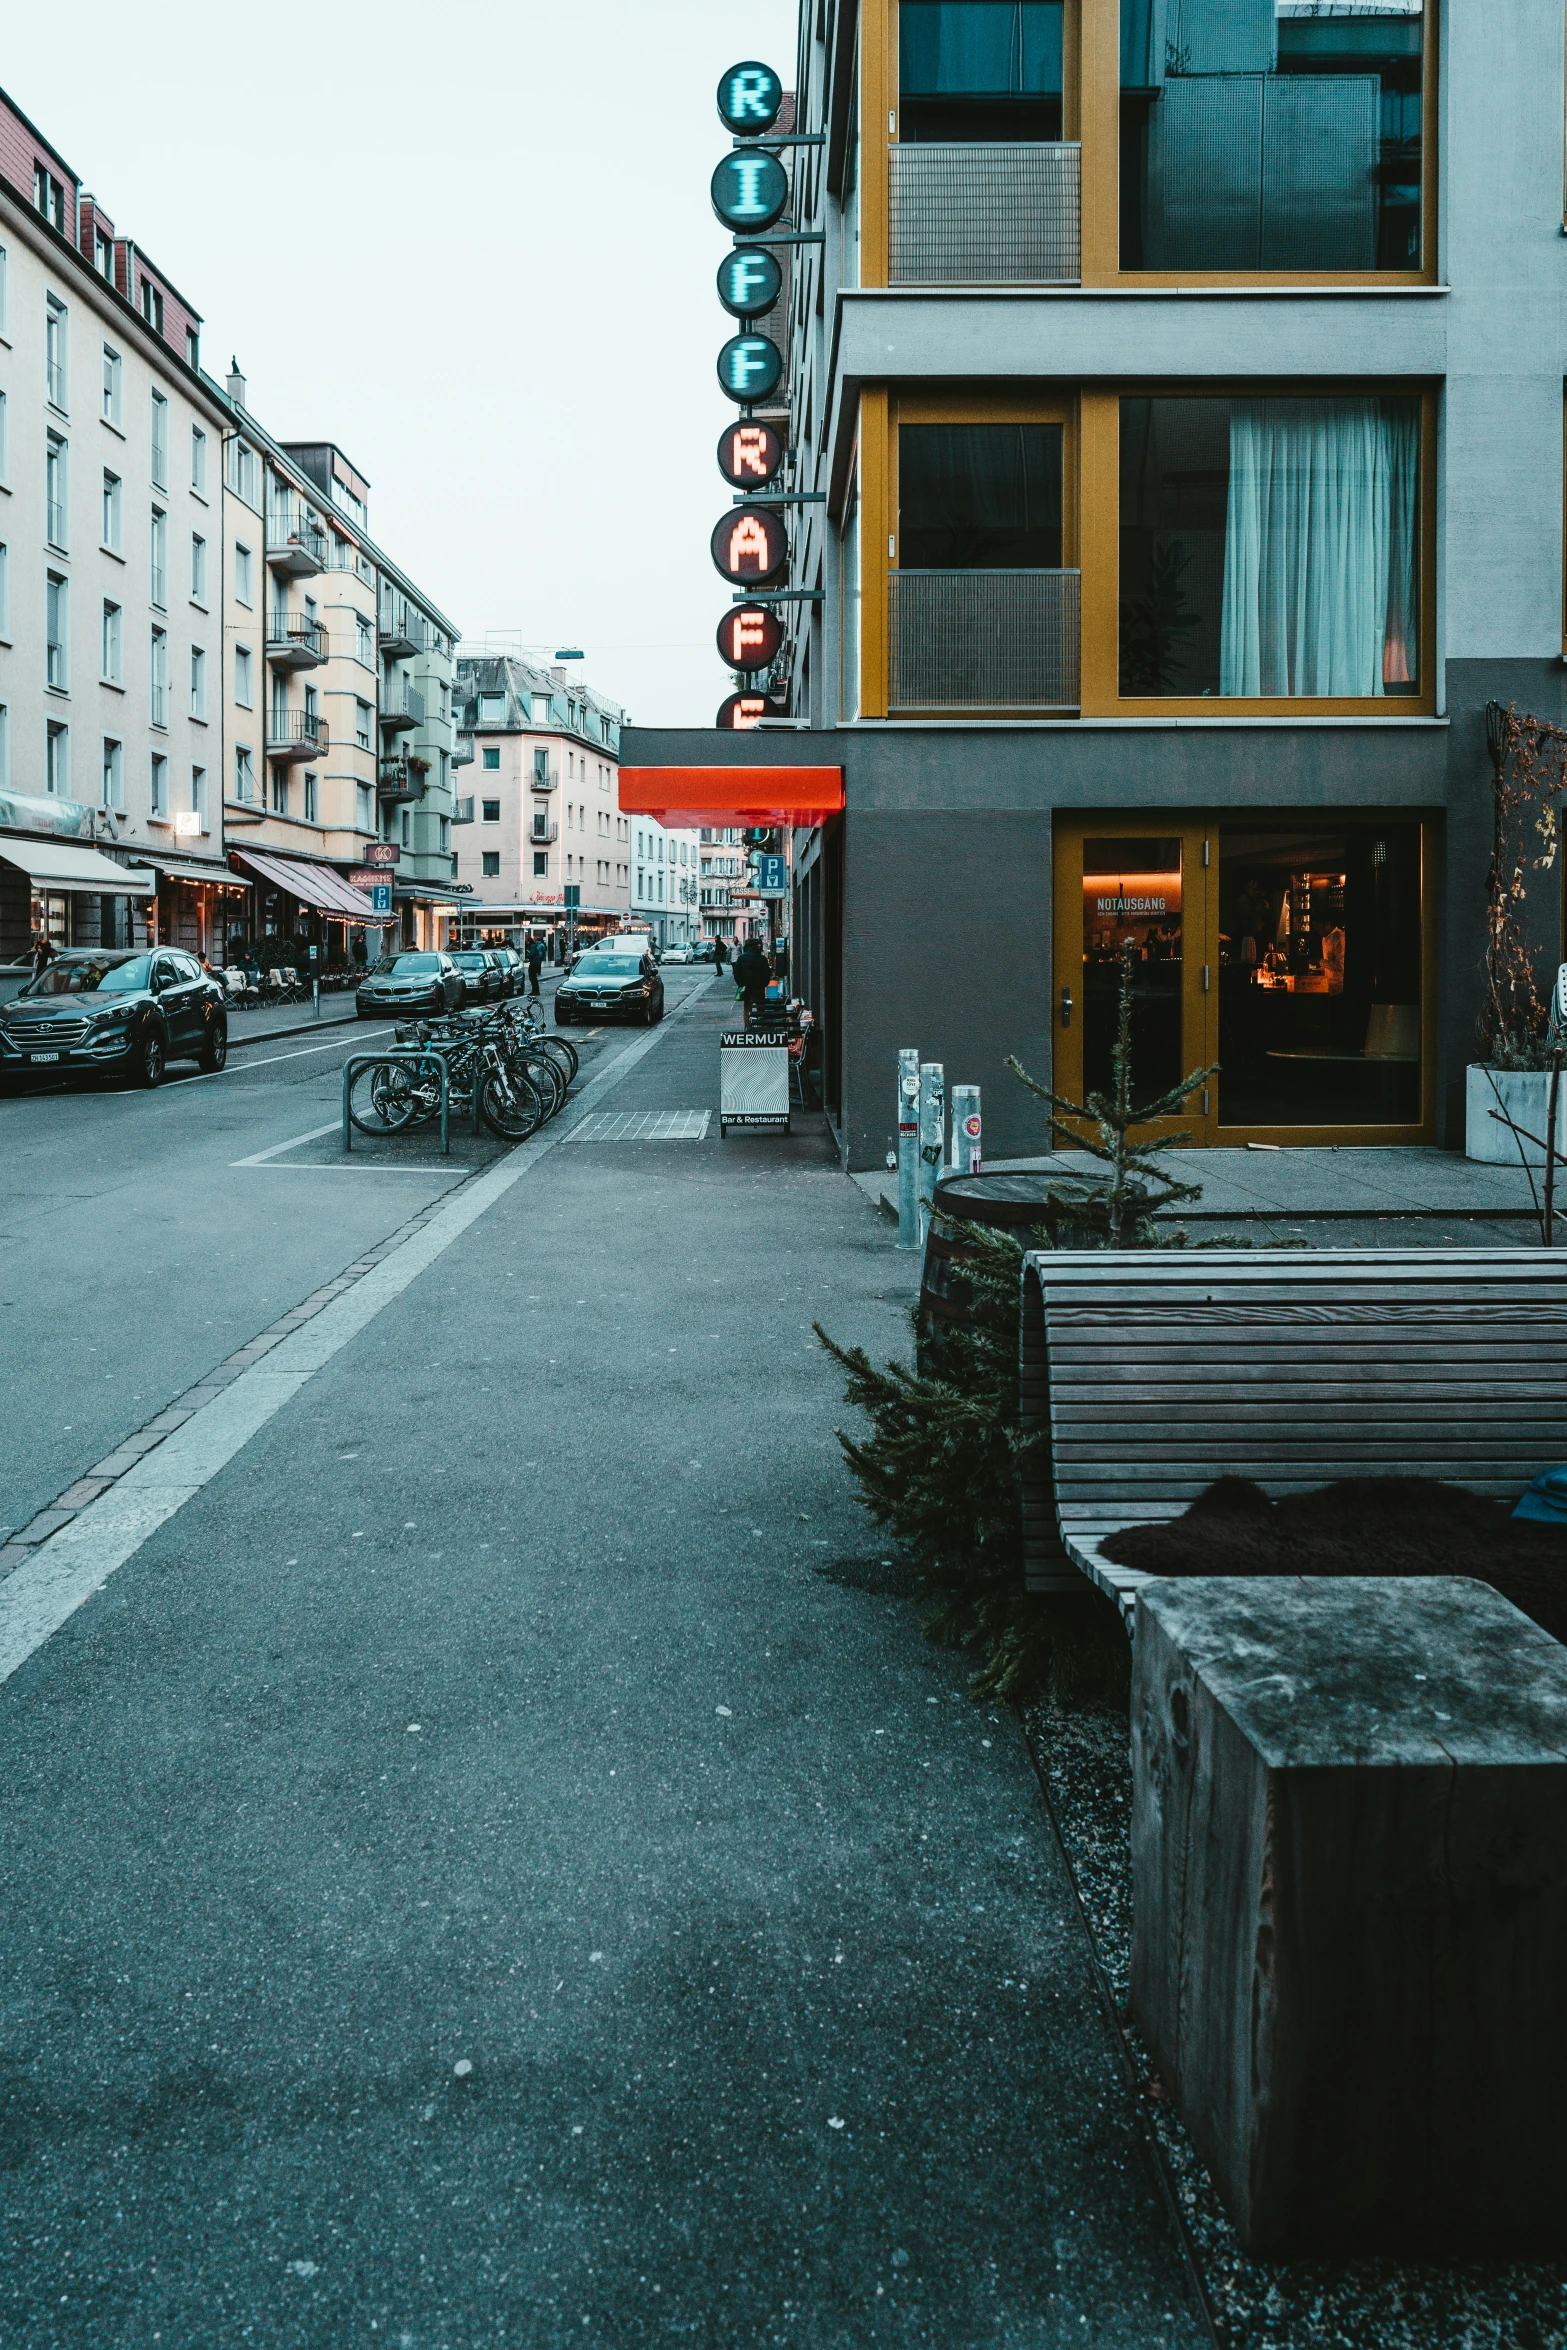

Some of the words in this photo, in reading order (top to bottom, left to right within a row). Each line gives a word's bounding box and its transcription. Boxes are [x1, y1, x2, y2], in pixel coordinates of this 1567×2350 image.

[768, 858, 778, 875] P
[378, 888, 386, 900] P
[1097, 898, 1166, 910] NOTAUSGANG
[723, 1033, 786, 1045] WERMUT
[721, 1116, 736, 1124] Bar
[736, 1116, 743, 1124] &
[744, 1115, 789, 1123] Restaurant
